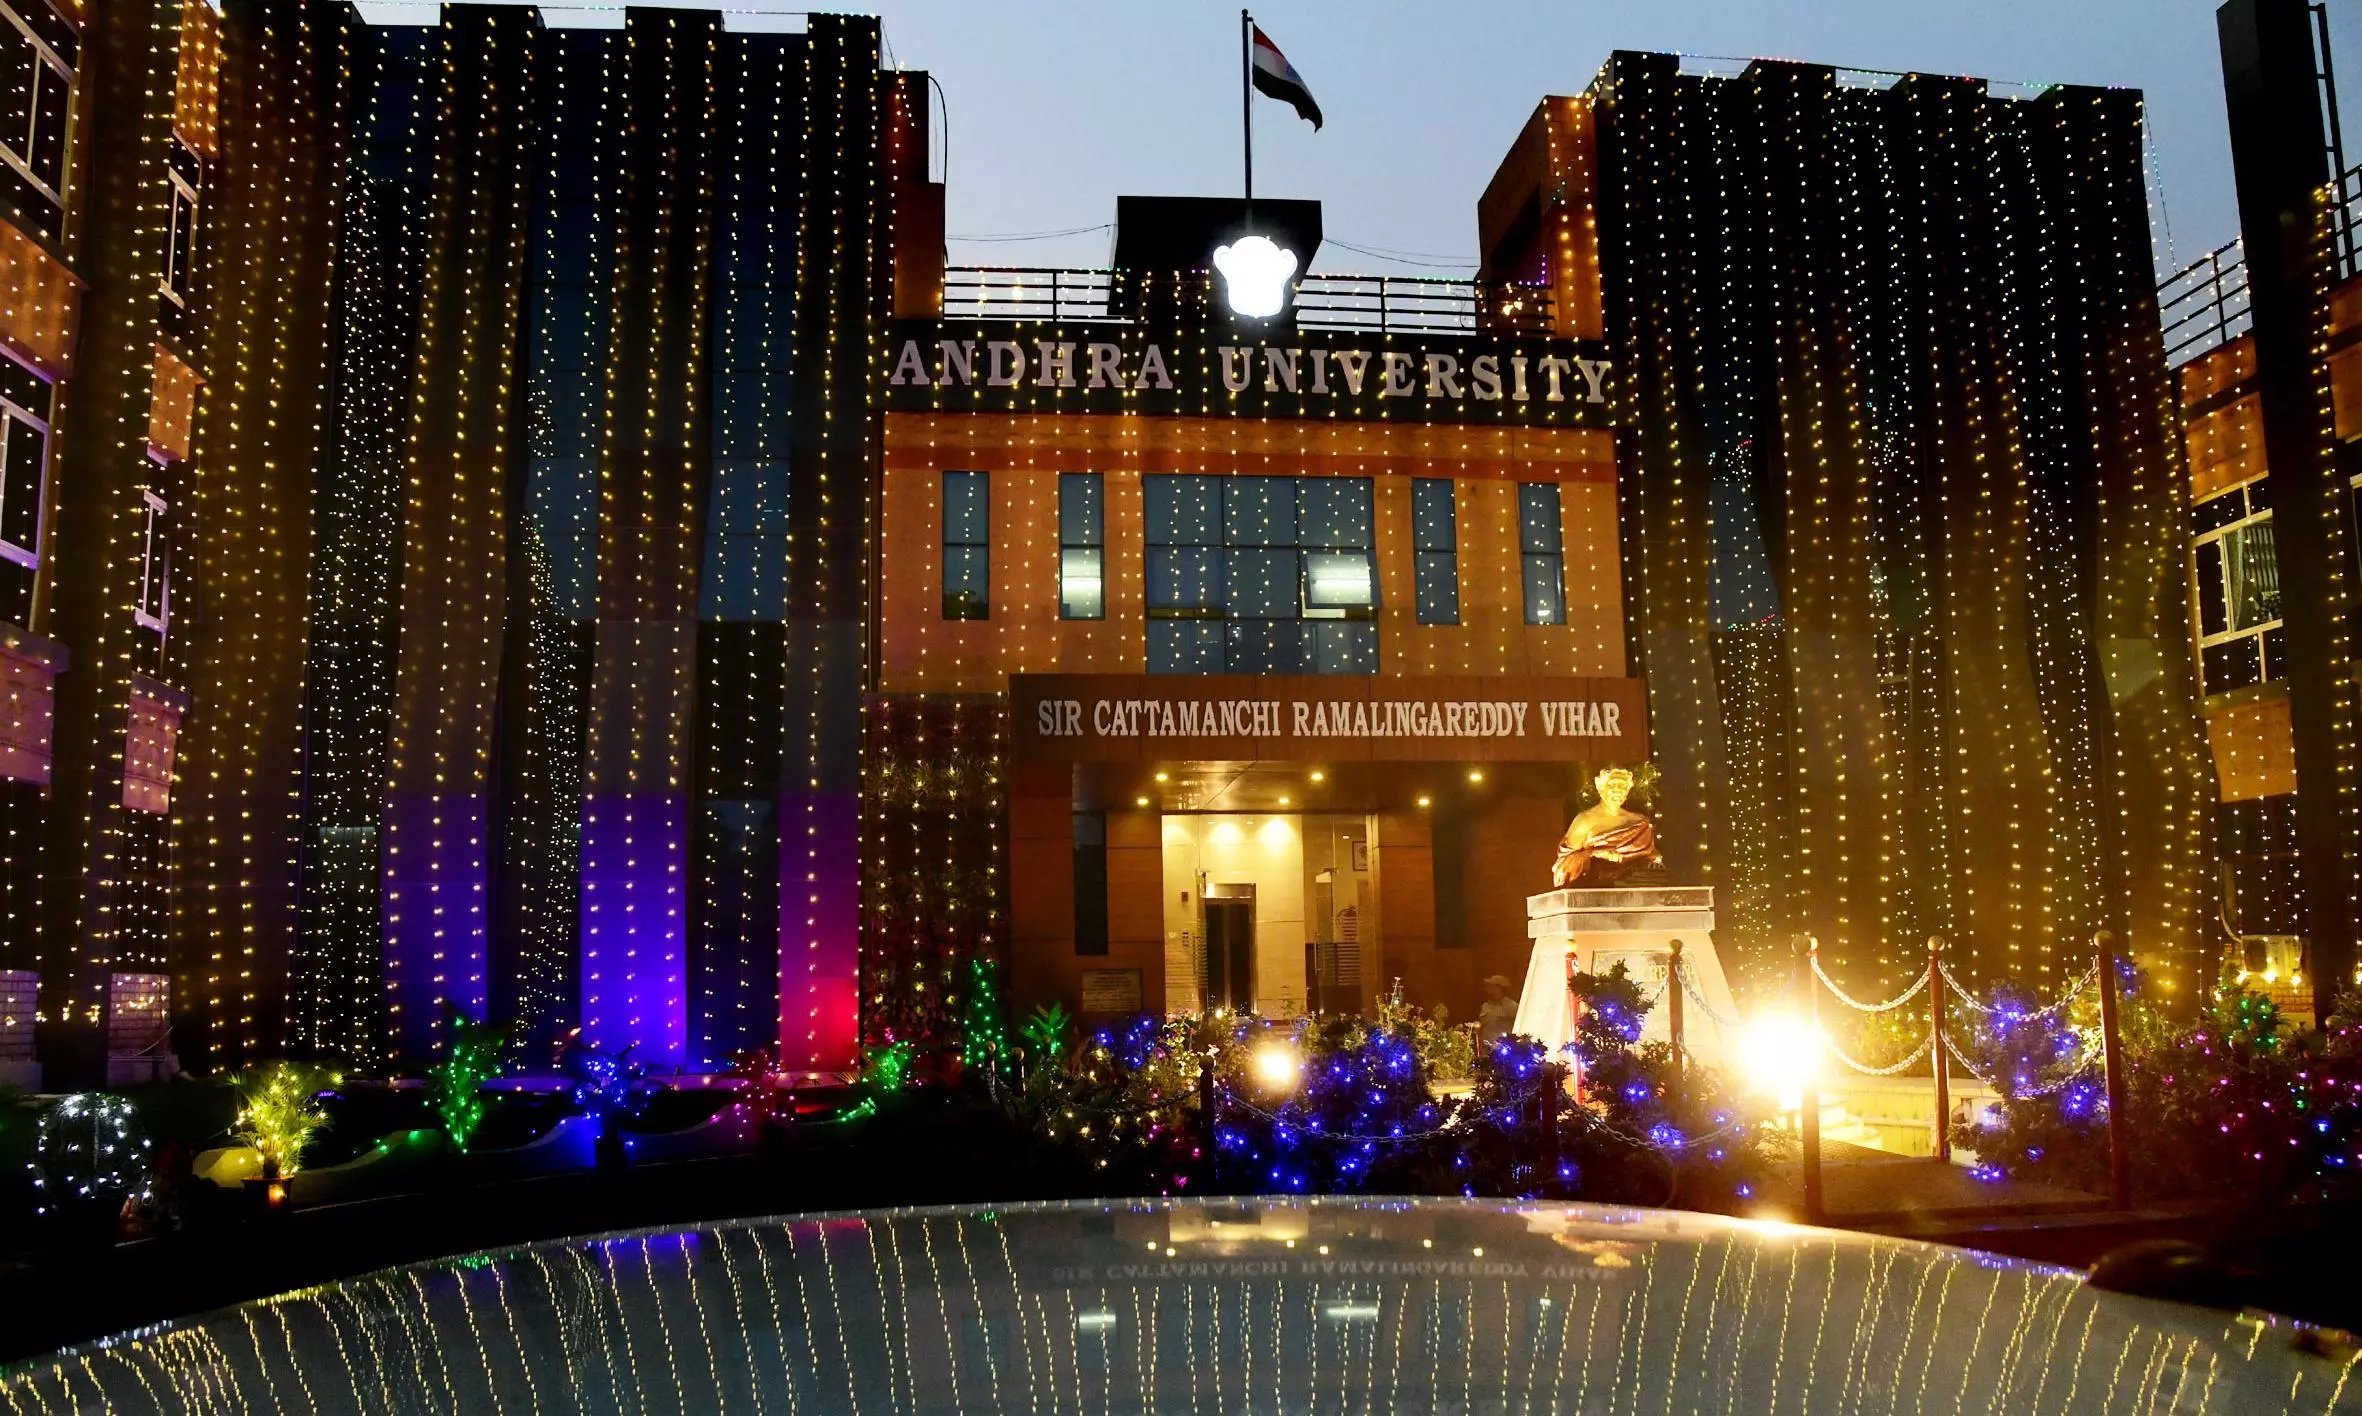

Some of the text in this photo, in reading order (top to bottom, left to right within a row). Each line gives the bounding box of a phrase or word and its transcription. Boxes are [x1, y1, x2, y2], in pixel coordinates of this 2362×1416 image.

[890, 339, 1612, 404] ANDHRA UNIVERSITY
[1038, 699, 1622, 737] SIR CATTAMANCHI RAMALINGAREDDY VIHAR
